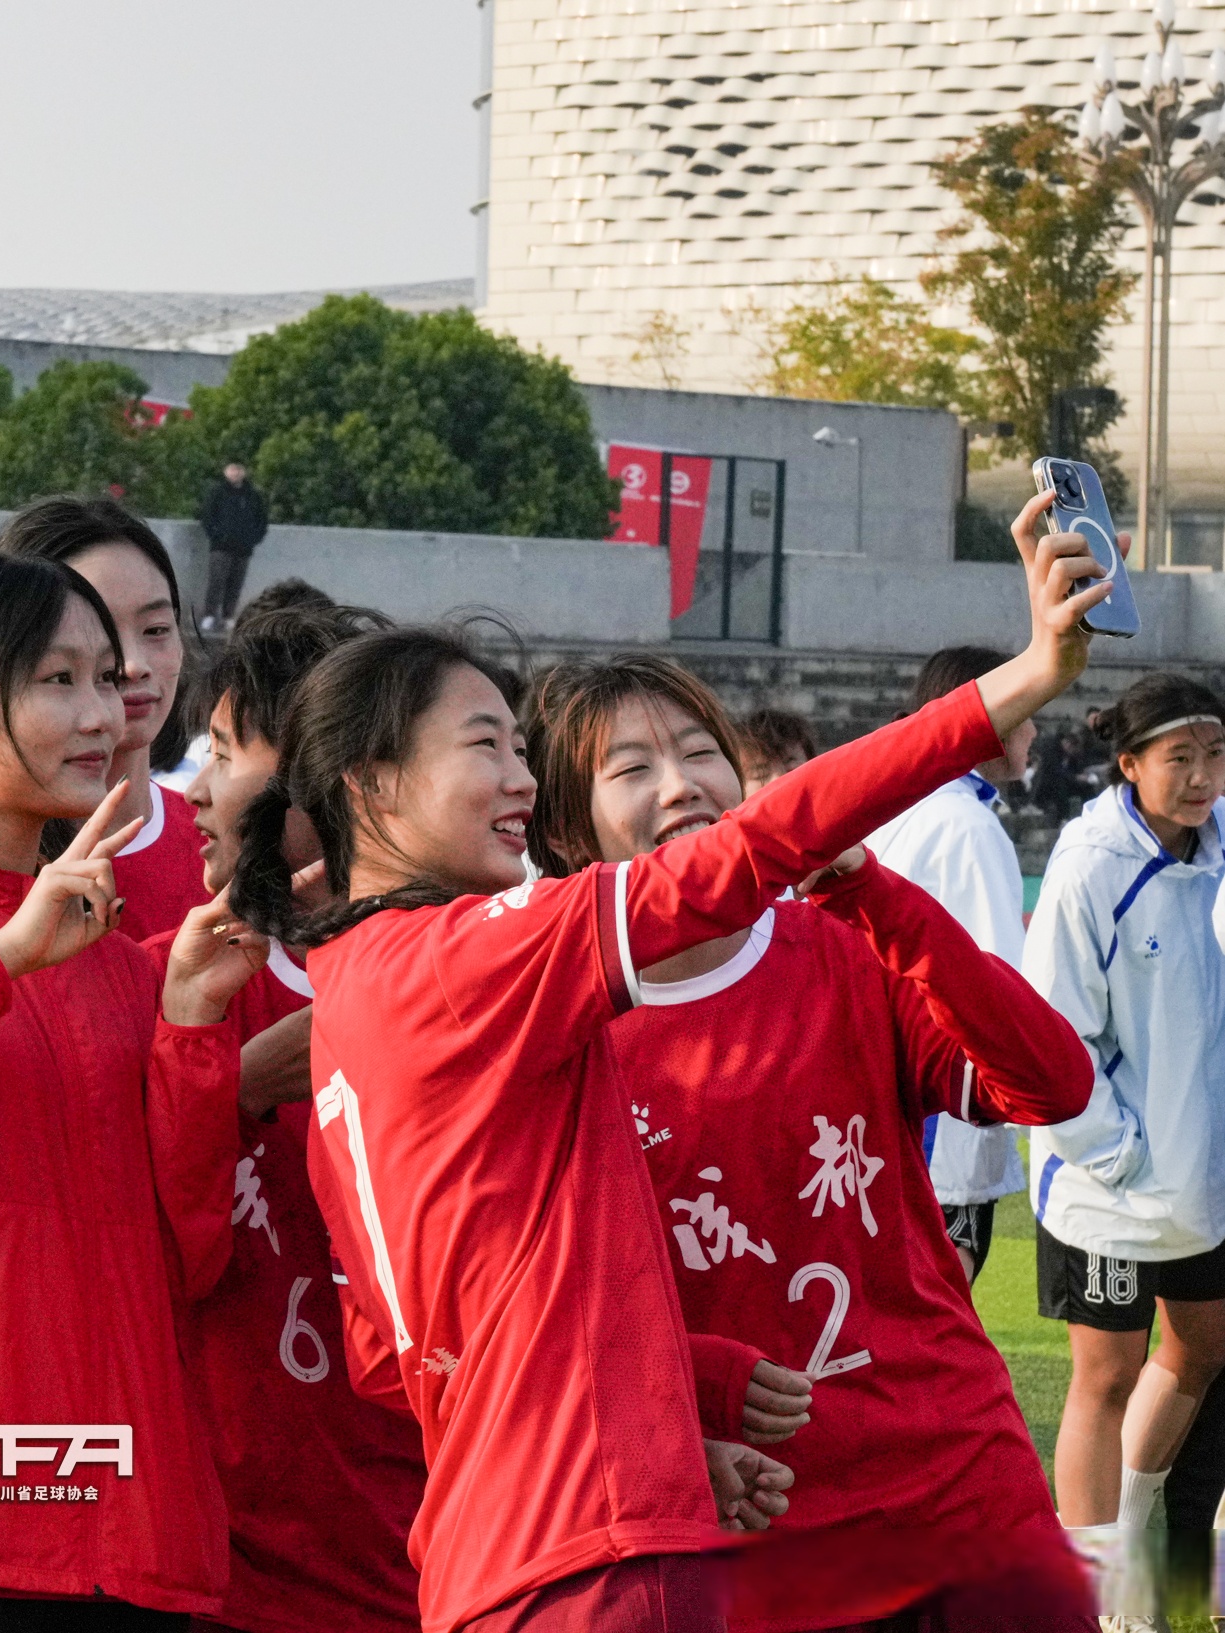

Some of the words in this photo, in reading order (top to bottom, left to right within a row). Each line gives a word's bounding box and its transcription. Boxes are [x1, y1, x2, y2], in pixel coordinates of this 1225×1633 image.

[640, 1127, 673, 1151] LME
[1084, 1252, 1138, 1305] 18
[279, 1276, 330, 1384] 6
[787, 1261, 873, 1381] 2
